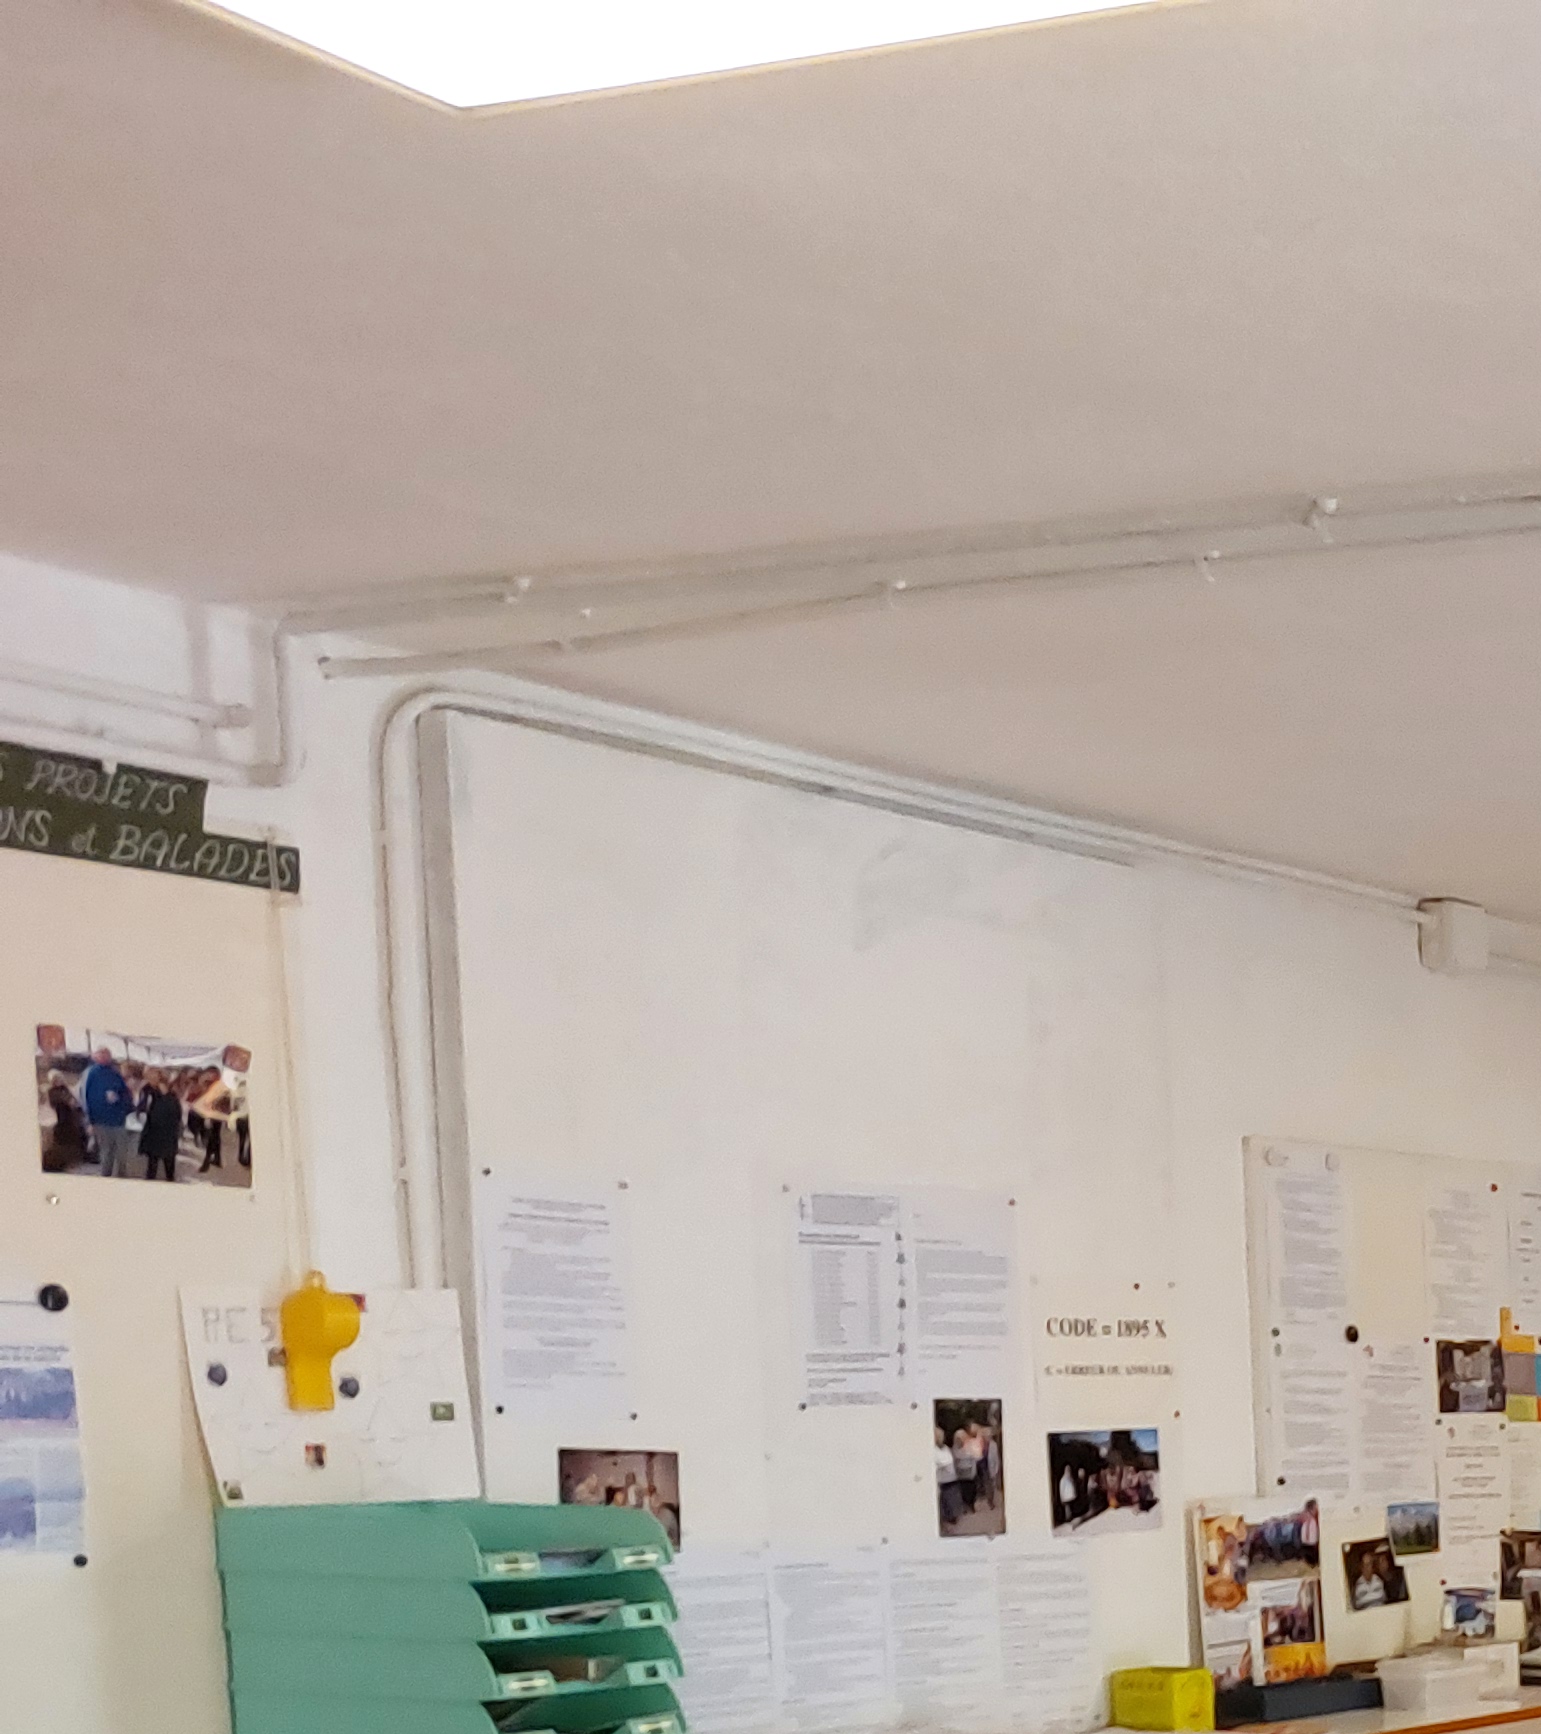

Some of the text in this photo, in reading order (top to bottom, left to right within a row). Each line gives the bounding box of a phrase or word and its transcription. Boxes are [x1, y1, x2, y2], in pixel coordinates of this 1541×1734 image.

[25, 759, 188, 814] PROJETS
[109, 824, 296, 887] BALADES
[1046, 1318, 1098, 1338] CODE
